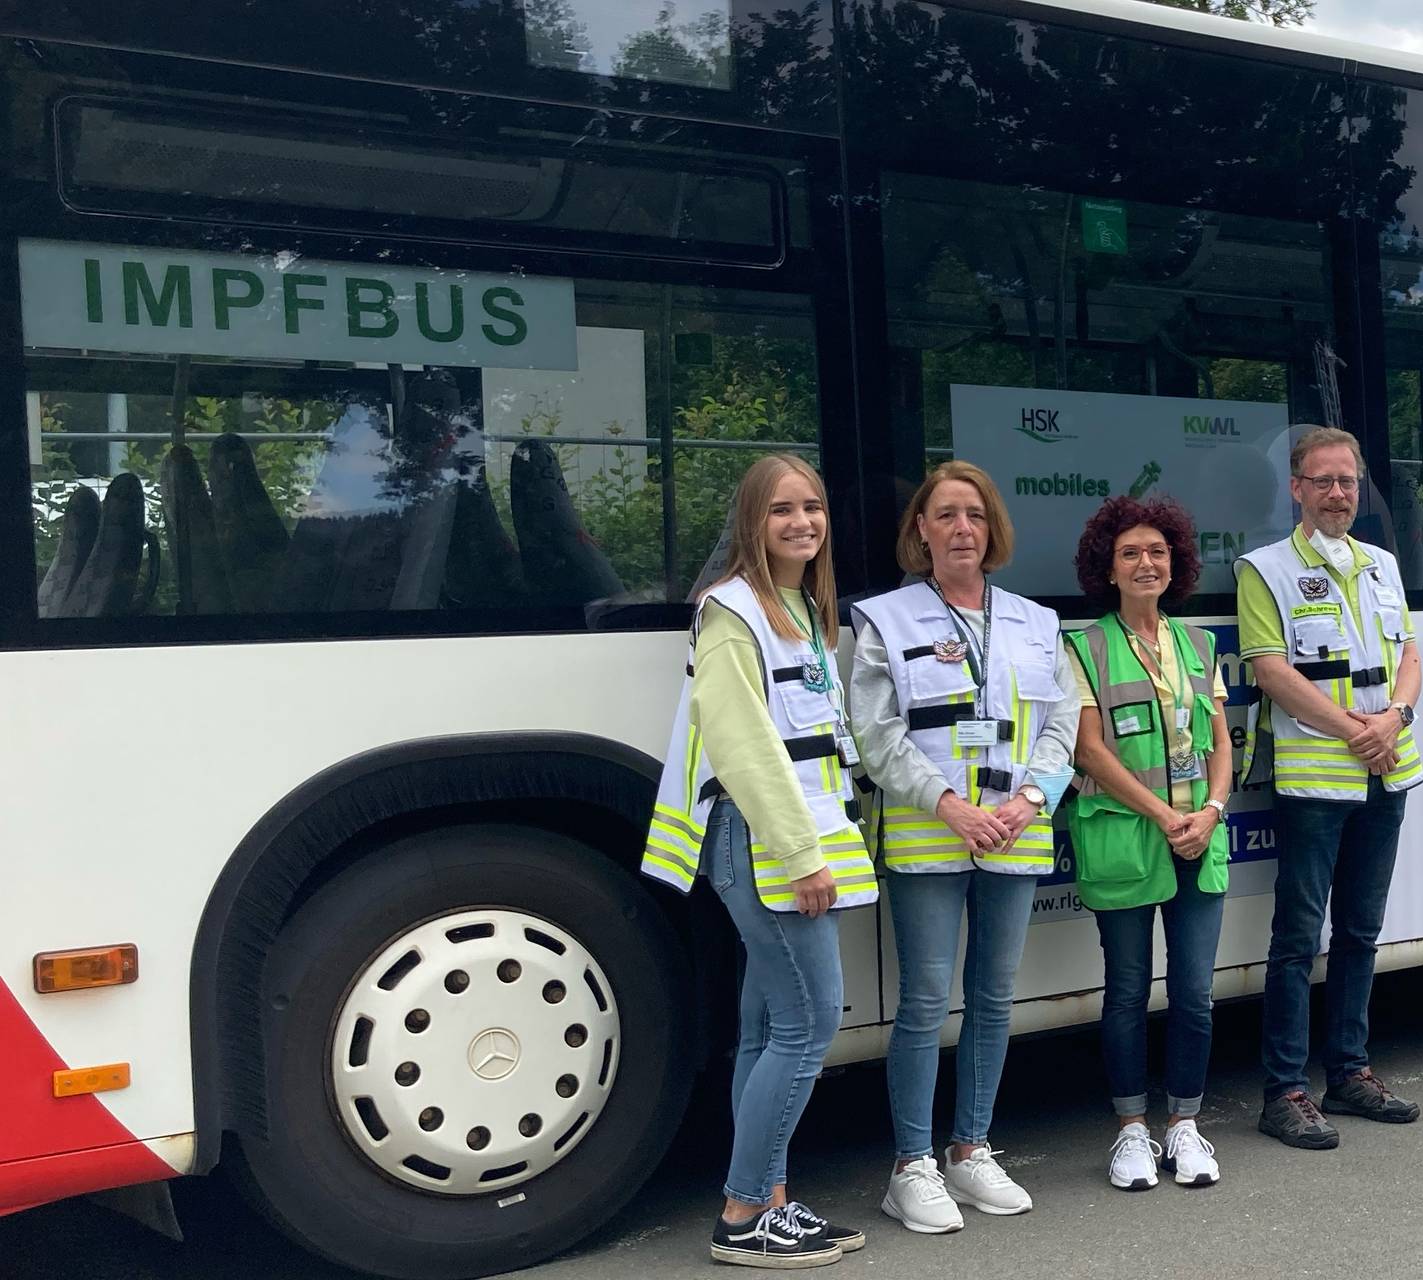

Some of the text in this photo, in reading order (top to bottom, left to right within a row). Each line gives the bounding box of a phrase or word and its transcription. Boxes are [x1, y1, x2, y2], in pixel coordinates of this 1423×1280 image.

[83, 258, 528, 346] IMPFBUS
[1021, 408, 1060, 433] HSK
[1183, 415, 1241, 436] KVWL
[1015, 472, 1111, 497] mobiles
[1246, 828, 1276, 851] zu
